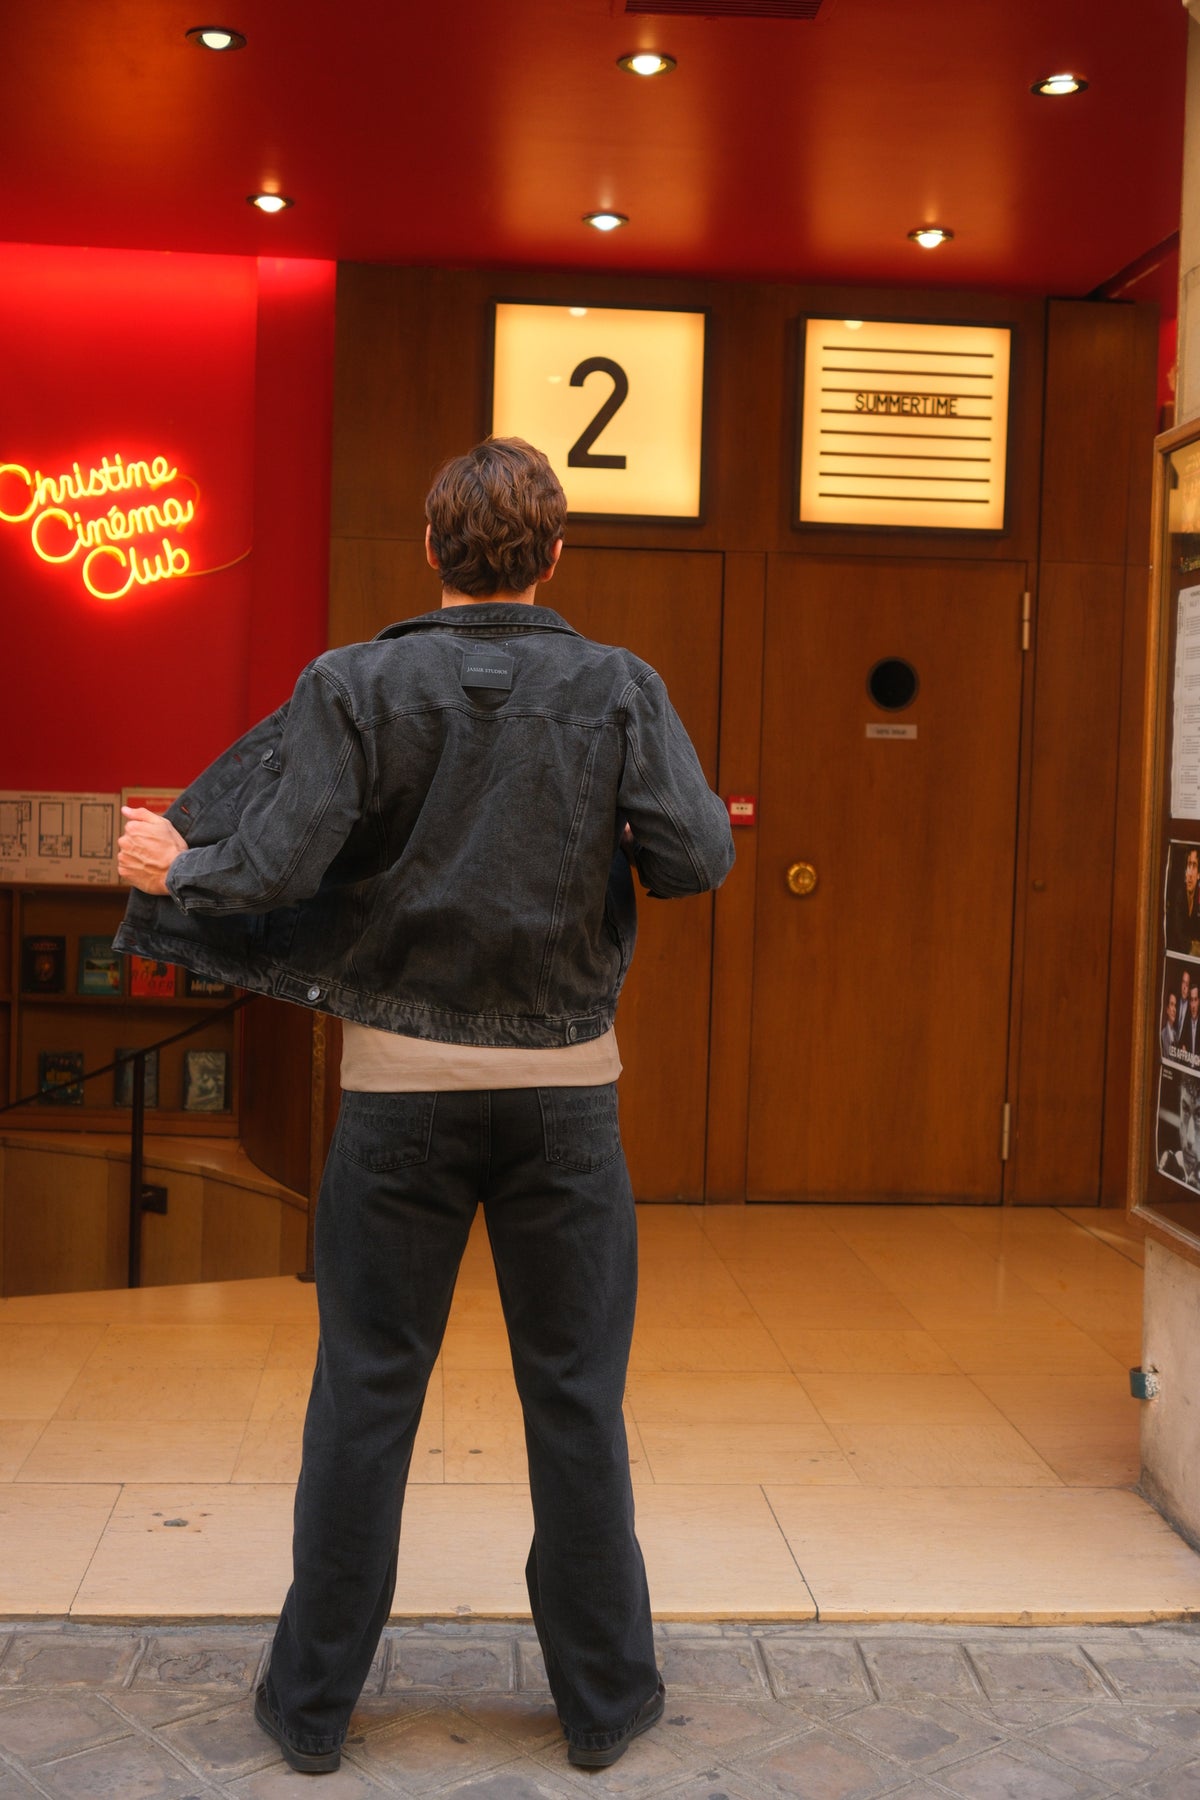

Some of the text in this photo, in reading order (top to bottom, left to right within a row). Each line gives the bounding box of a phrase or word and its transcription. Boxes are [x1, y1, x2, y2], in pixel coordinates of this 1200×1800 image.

[567, 356, 629, 470] 2
[855, 393, 958, 416] SUMMERTIME
[0, 454, 177, 522] Christine
[31, 497, 194, 563] Cinéma
[82, 538, 190, 600] Club
